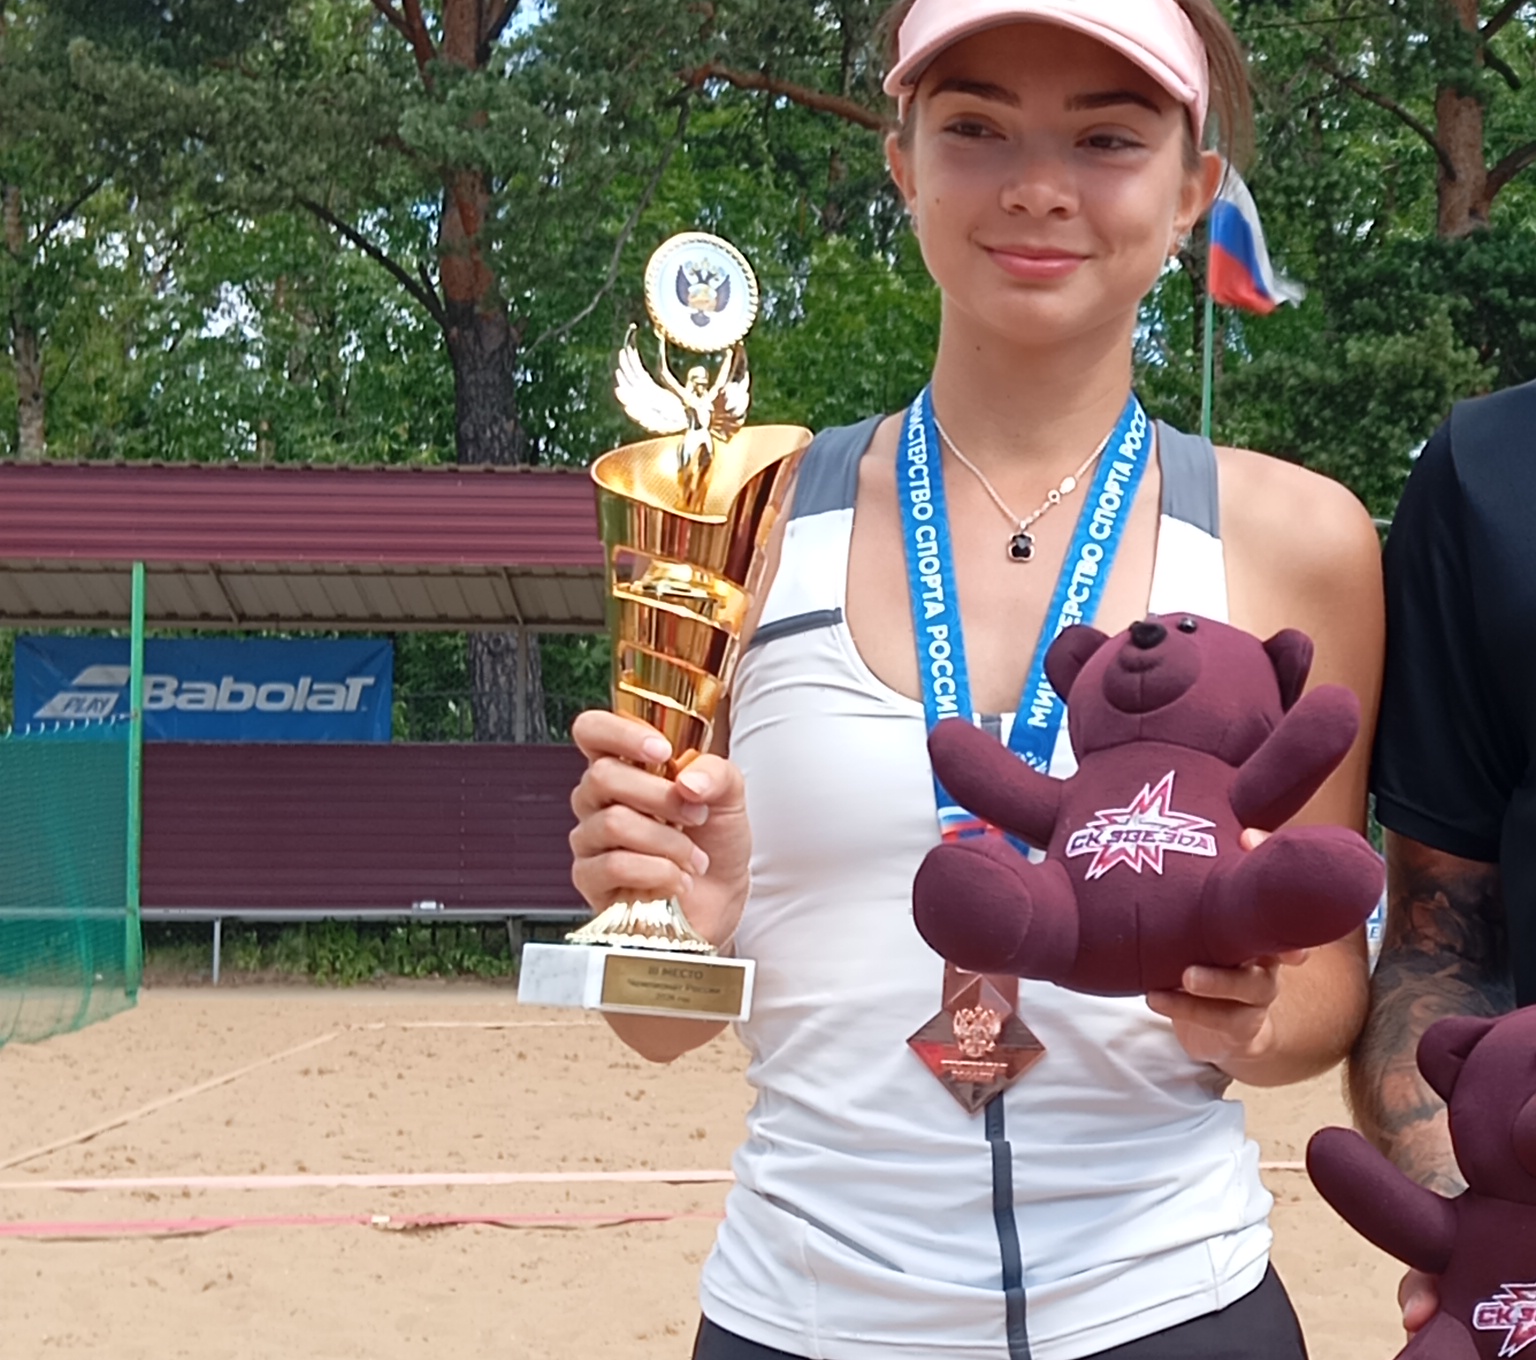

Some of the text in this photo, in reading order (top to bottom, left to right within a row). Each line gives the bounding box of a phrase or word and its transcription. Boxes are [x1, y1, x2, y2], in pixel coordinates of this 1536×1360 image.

[1089, 460, 1134, 540] СПОРТА
[915, 525, 945, 619] СПОРТА
[1071, 830, 1104, 852] СК
[661, 967, 704, 981] МЕСТО
[1478, 1308, 1512, 1324] СК
